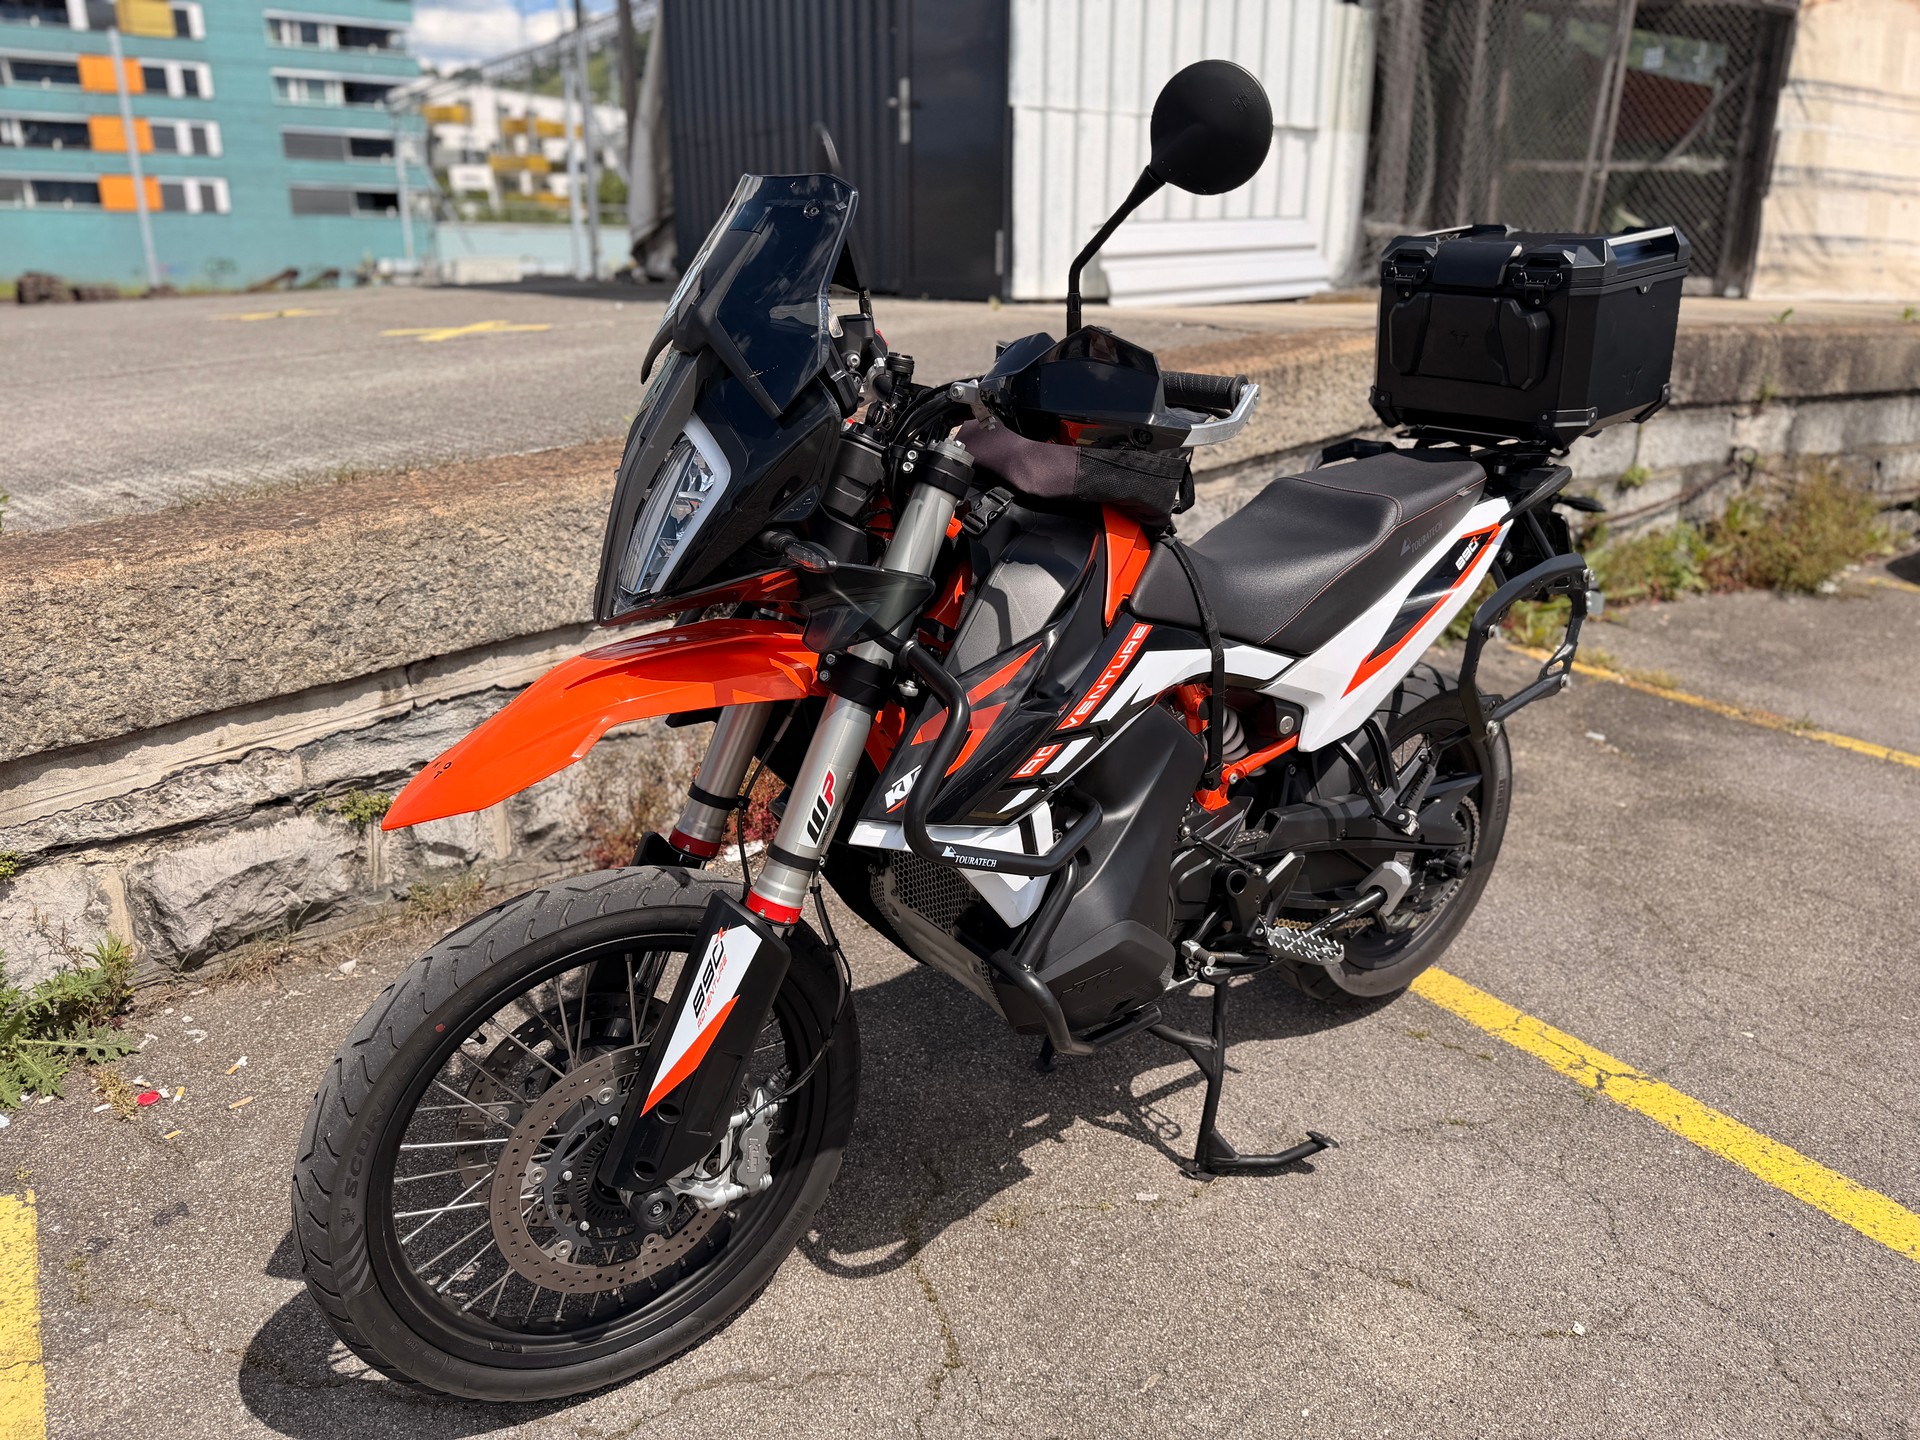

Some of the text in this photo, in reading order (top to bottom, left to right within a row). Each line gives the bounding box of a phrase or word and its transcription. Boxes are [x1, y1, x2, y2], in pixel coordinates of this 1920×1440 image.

[1411, 520, 1443, 553] TOURATECH
[884, 764, 922, 809] KT
[955, 855, 998, 868] TOURATECH
[697, 954, 728, 1030] ADVENTURE
